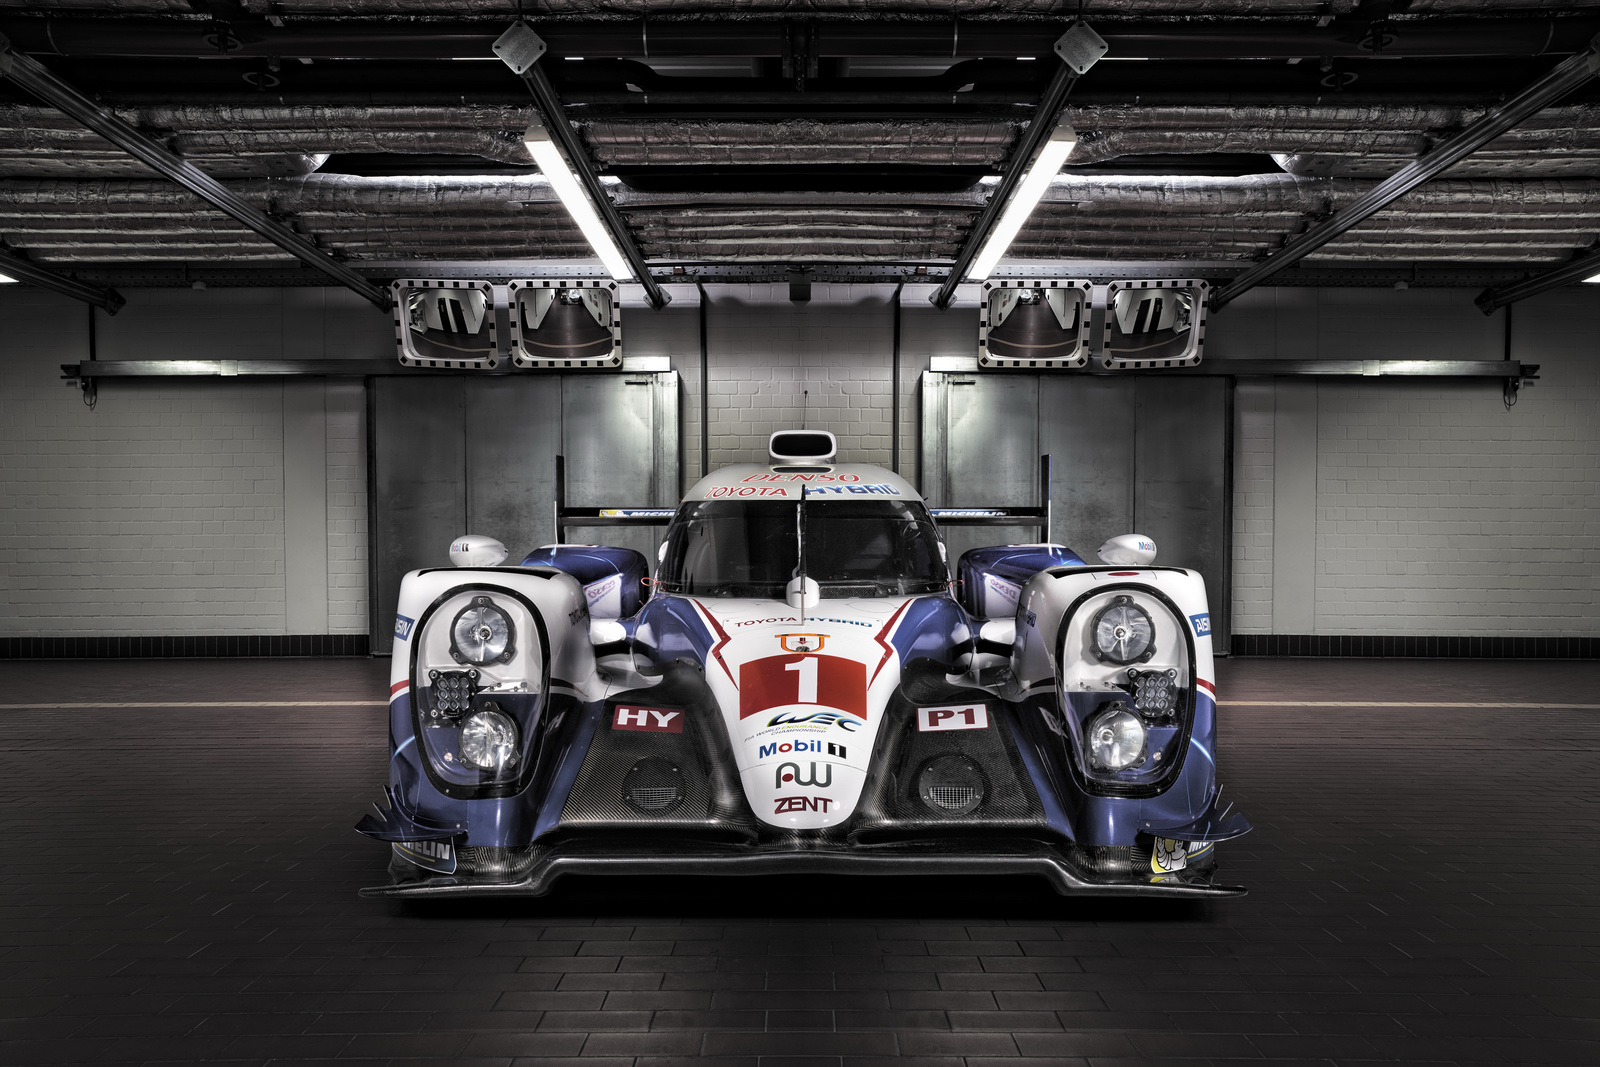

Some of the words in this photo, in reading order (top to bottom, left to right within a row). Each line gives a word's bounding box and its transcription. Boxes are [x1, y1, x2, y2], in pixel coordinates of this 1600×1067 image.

[741, 473, 860, 483] DENSO
[704, 486, 789, 498] TOYOTA
[802, 484, 901, 496] HYBRID
[735, 617, 797, 627] TOYOTA
[804, 617, 872, 628] HYBRID
[785, 657, 818, 703] 1
[617, 708, 680, 728] HY
[767, 712, 862, 732] WEC
[928, 708, 976, 727] P1
[759, 740, 822, 759] Mobil
[774, 796, 833, 815] ZENT
